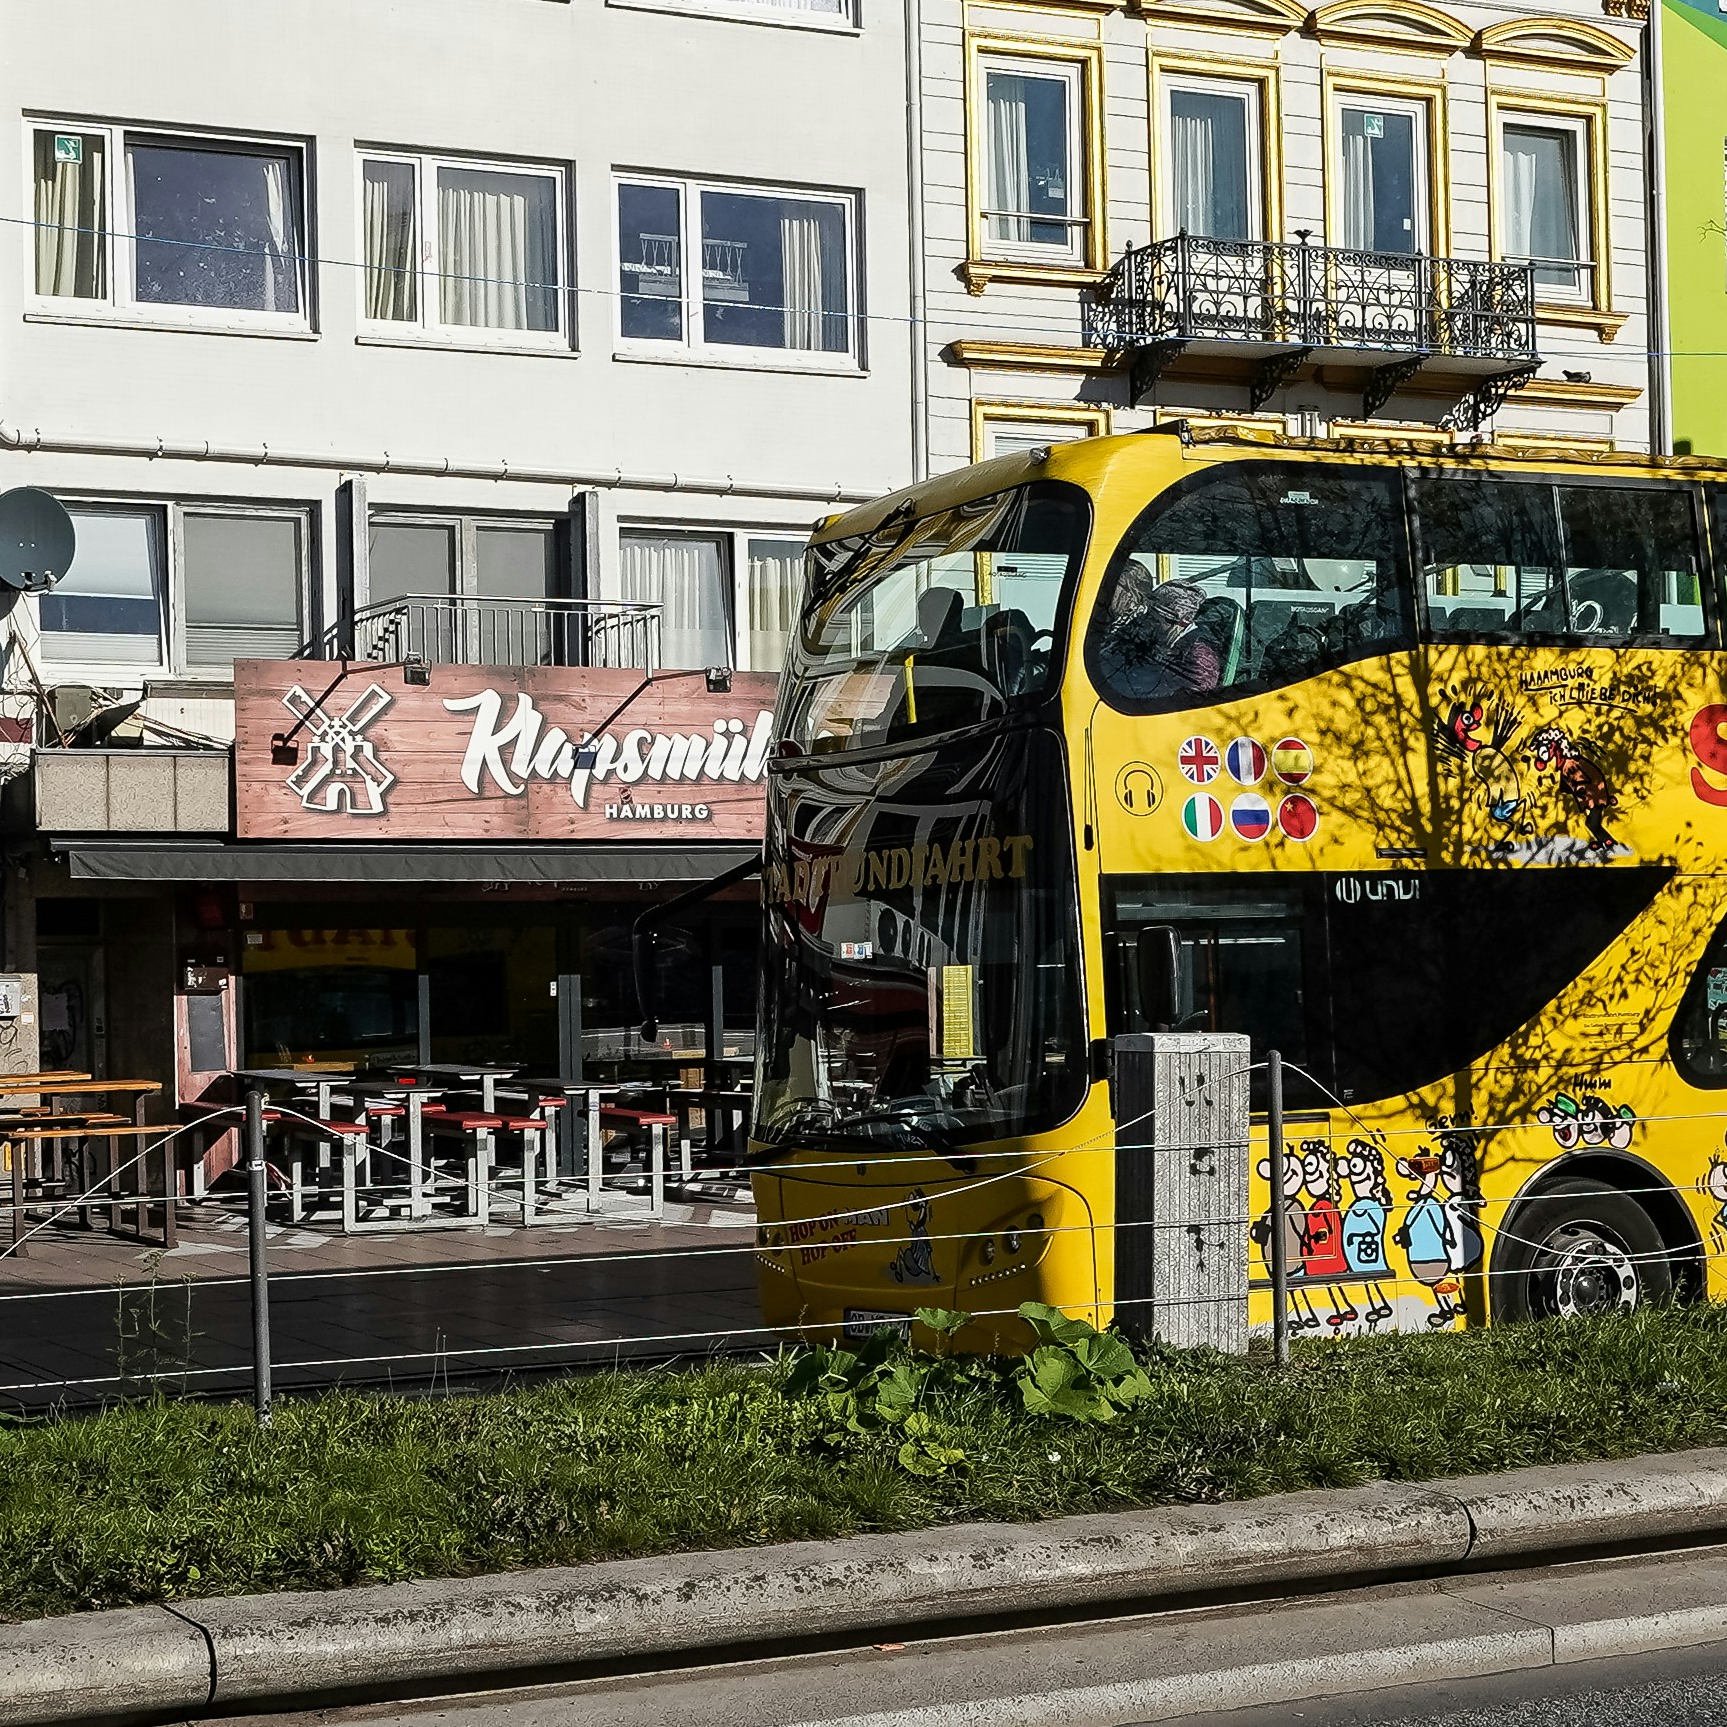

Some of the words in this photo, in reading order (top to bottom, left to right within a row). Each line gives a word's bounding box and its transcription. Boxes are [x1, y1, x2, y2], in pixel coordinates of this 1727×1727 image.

[604, 803, 710, 820] HAMBURG
[760, 835, 1034, 904] TADTRUNDFAHRT
[789, 1223, 816, 1244] HOP
